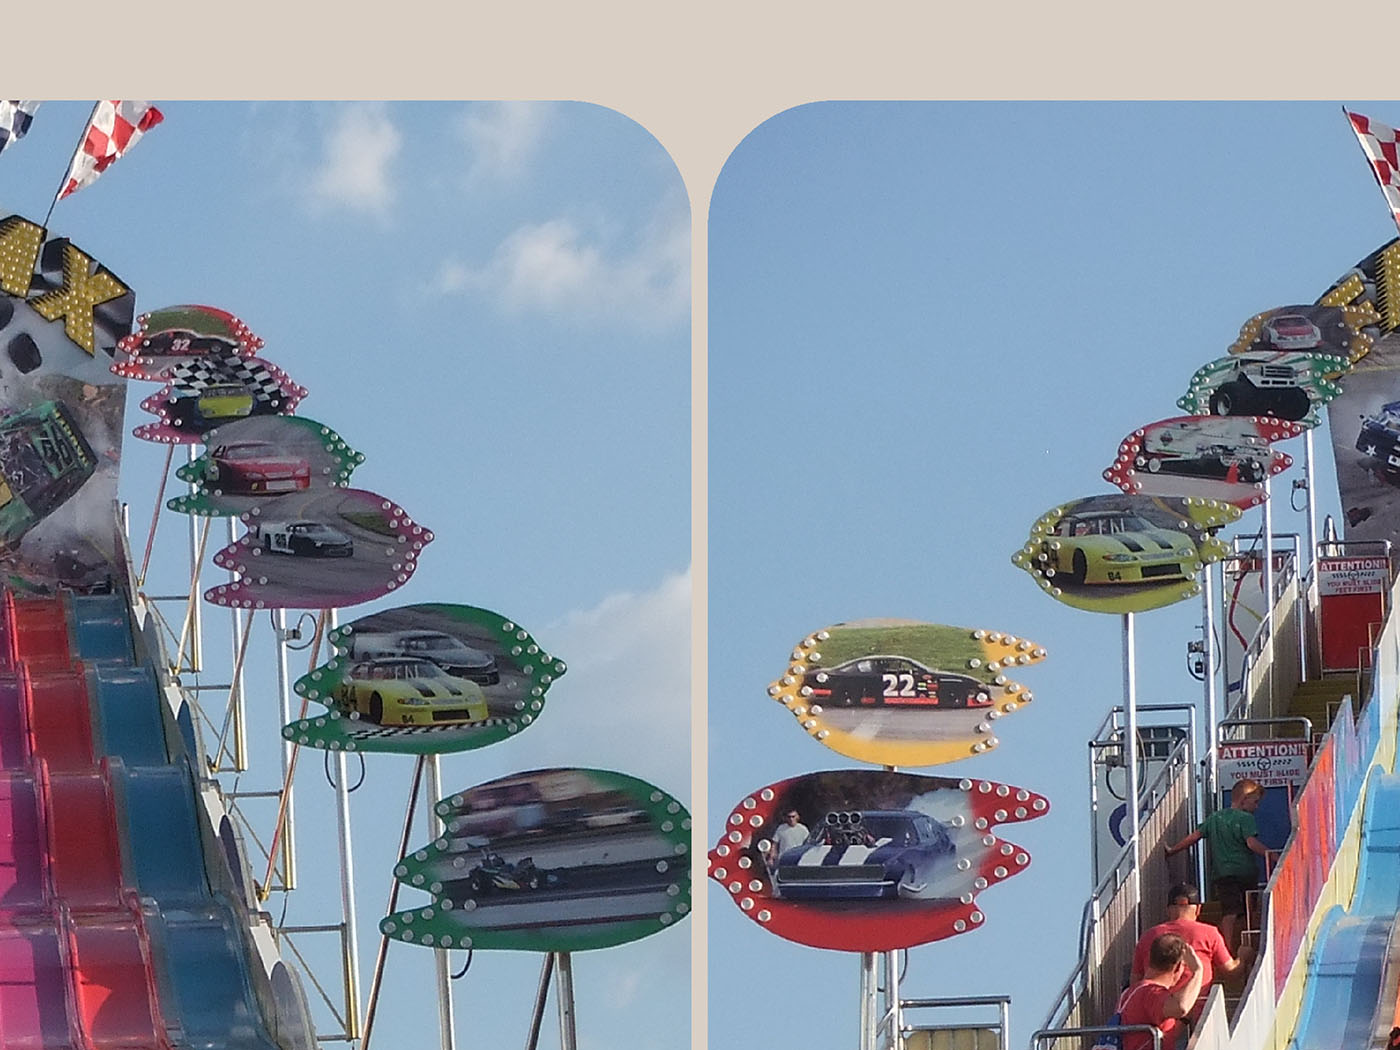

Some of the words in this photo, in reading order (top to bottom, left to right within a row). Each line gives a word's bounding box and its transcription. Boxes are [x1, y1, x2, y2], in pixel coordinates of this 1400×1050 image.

[171, 339, 191, 351] 32
[1321, 559, 1386, 570] ATTENTION!!
[1108, 571, 1122, 581] 84
[882, 674, 916, 697] 22
[1222, 744, 1305, 759] ATTENTION!!
[1230, 771, 1248, 779] YOU
[1250, 770, 1273, 778] MUST
